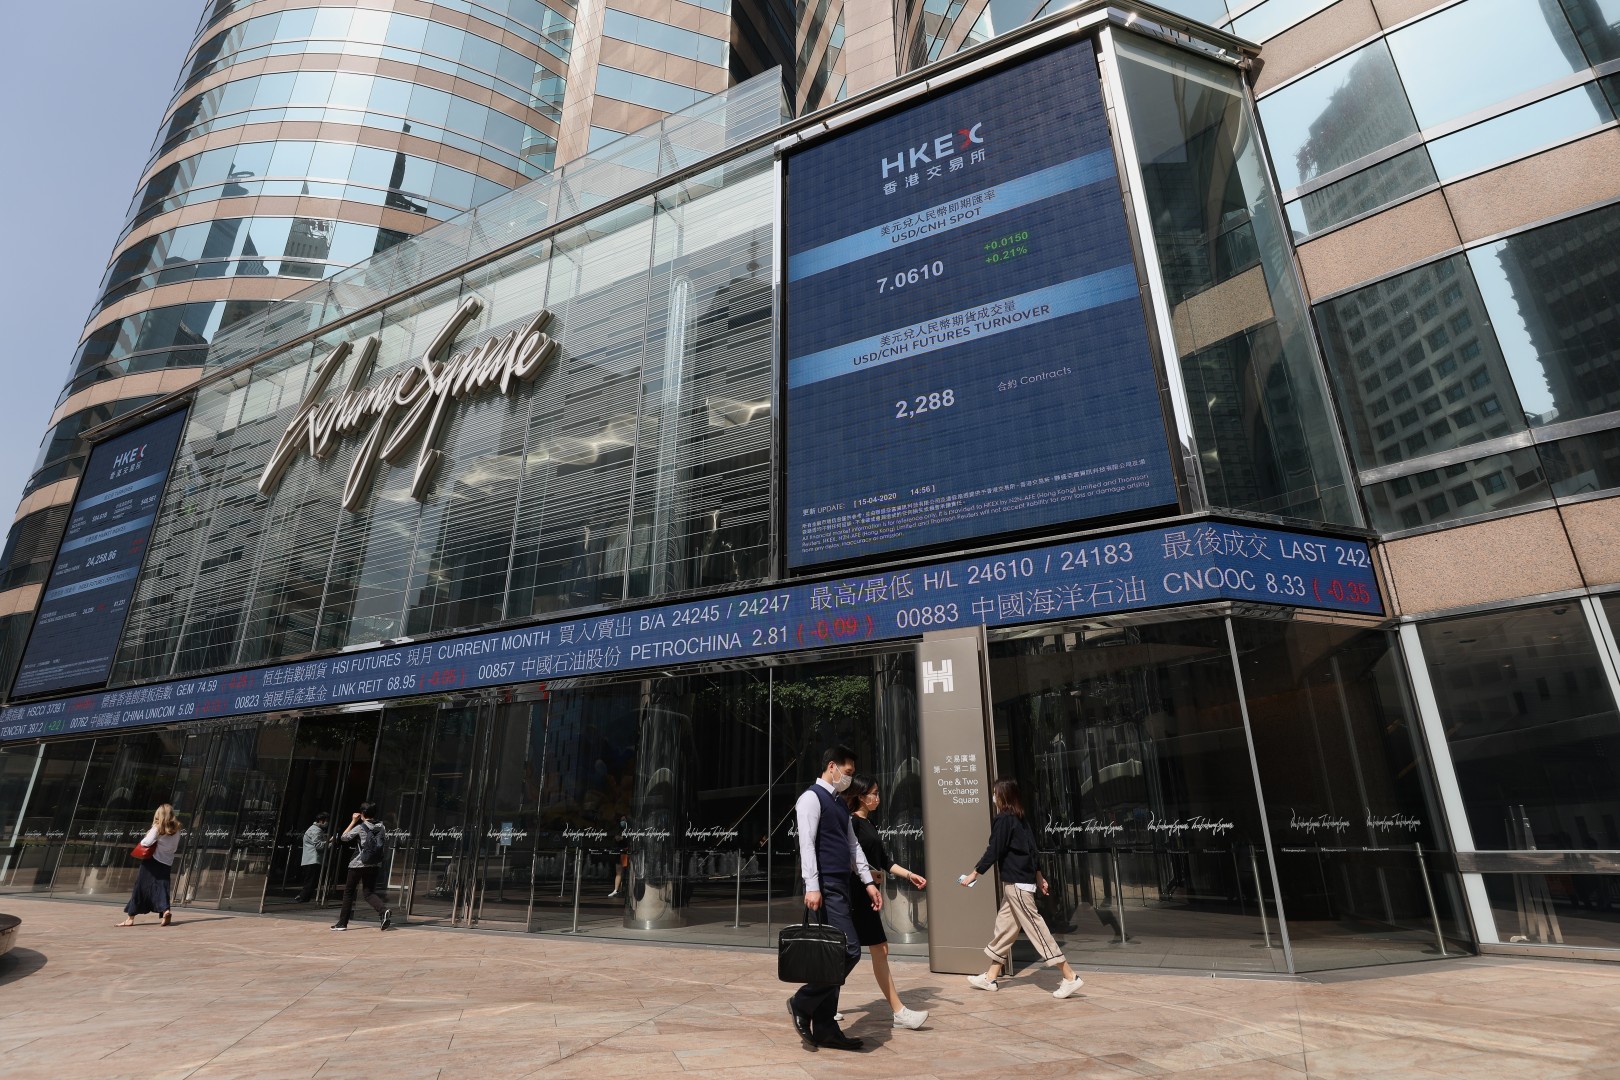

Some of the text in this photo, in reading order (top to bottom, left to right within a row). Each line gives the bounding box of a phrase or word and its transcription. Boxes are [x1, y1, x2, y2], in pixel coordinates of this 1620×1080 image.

[881, 122, 984, 179] HKEX
[883, 149, 986, 196] 香港交易所
[892, 207, 982, 244] USD/CNH SPOT
[983, 231, 1029, 251] +0.0150
[985, 245, 1028, 264] +0.21%
[877, 260, 944, 295] 7.0610
[853, 304, 1050, 367] USD/CNH FUTURES TURNOVER
[1019, 364, 1072, 386] Contracts
[895, 389, 955, 419] 2,288
[113, 443, 148, 469] HKEX
[331, 660, 350, 676] HSI
[349, 653, 402, 673] FUTURES
[406, 645, 433, 667] 現月
[437, 637, 499, 661] CURRENT
[500, 629, 551, 652] MONTH
[639, 612, 666, 632] B/A
[671, 604, 720, 627] 24245
[738, 594, 790, 618] 24247
[809, 573, 914, 611] 最高/最低
[923, 569, 958, 592] H/L
[967, 557, 1034, 585] 24610
[1060, 541, 1134, 572] 24183
[1160, 526, 1272, 561] 最後成交
[1279, 538, 1327, 564] LAST
[1334, 546, 1371, 568] 242
[896, 602, 960, 629] 00883
[971, 575, 1147, 623] 中國海洋石油
[1162, 566, 1256, 594] CNOOC
[1265, 572, 1306, 597] 8.33
[477, 661, 516, 681] 00857
[521, 645, 622, 679] 中國石油股份
[630, 632, 742, 662] PETROCHINA
[752, 625, 788, 648] 2.81
[176, 683, 195, 697] GEM
[196, 679, 218, 693] 74.59
[234, 694, 260, 709] 00823
[332, 683, 356, 698] LINK
[357, 678, 383, 694] REIT
[387, 674, 416, 691] 68.95
[122, 708, 144, 723] CHINA
[145, 704, 176, 720] UNICOM
[177, 702, 195, 716] 5.09
[937, 777, 979, 787] One & Two
[942, 787, 979, 797] Exchange
[952, 796, 980, 805] Square
